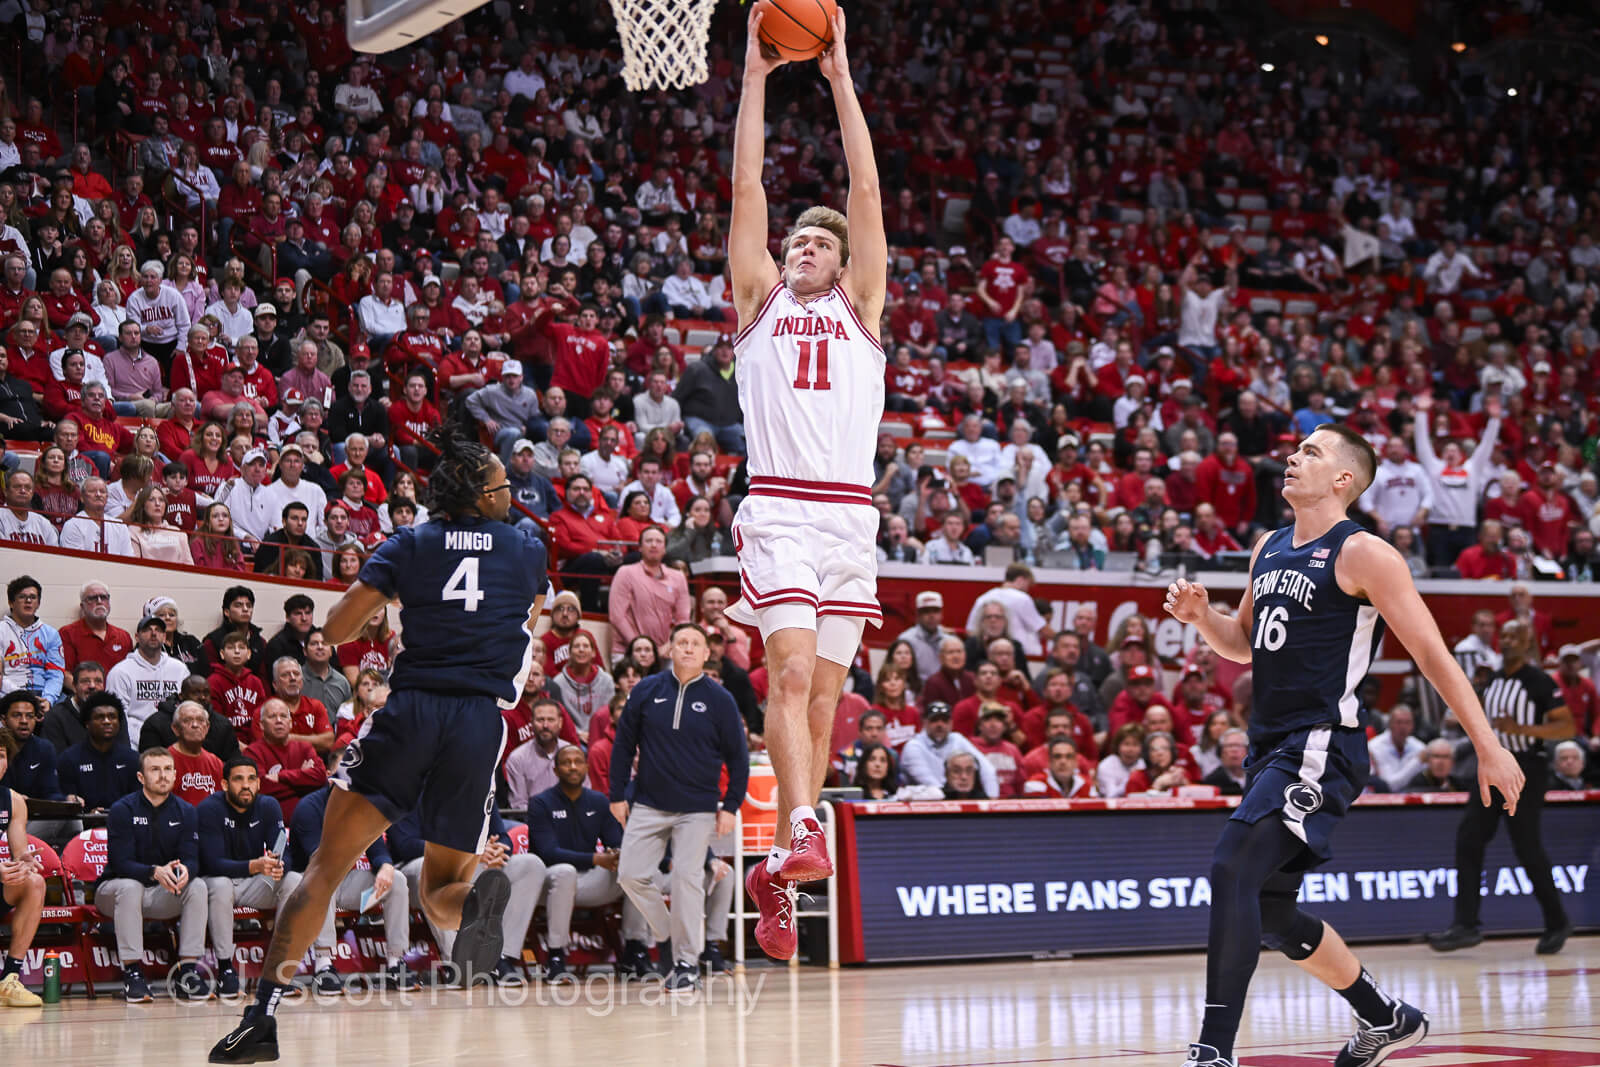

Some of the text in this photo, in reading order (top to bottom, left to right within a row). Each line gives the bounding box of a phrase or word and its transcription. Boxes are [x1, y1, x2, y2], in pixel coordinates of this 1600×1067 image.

[772, 315, 850, 341] INDIANA
[793, 339, 831, 390] 11
[167, 503, 191, 514] DIANA
[174, 512, 183, 526] 4
[445, 531, 492, 551] MINGO
[442, 557, 484, 612] 4
[1253, 569, 1317, 612] PENN STATE
[1254, 606, 1289, 652] 16
[224, 685, 258, 704] INIANA
[224, 817, 235, 828] PU
[896, 882, 1037, 917] WHERE
[1045, 879, 1141, 912] FANS
[1148, 876, 1212, 909] STA
